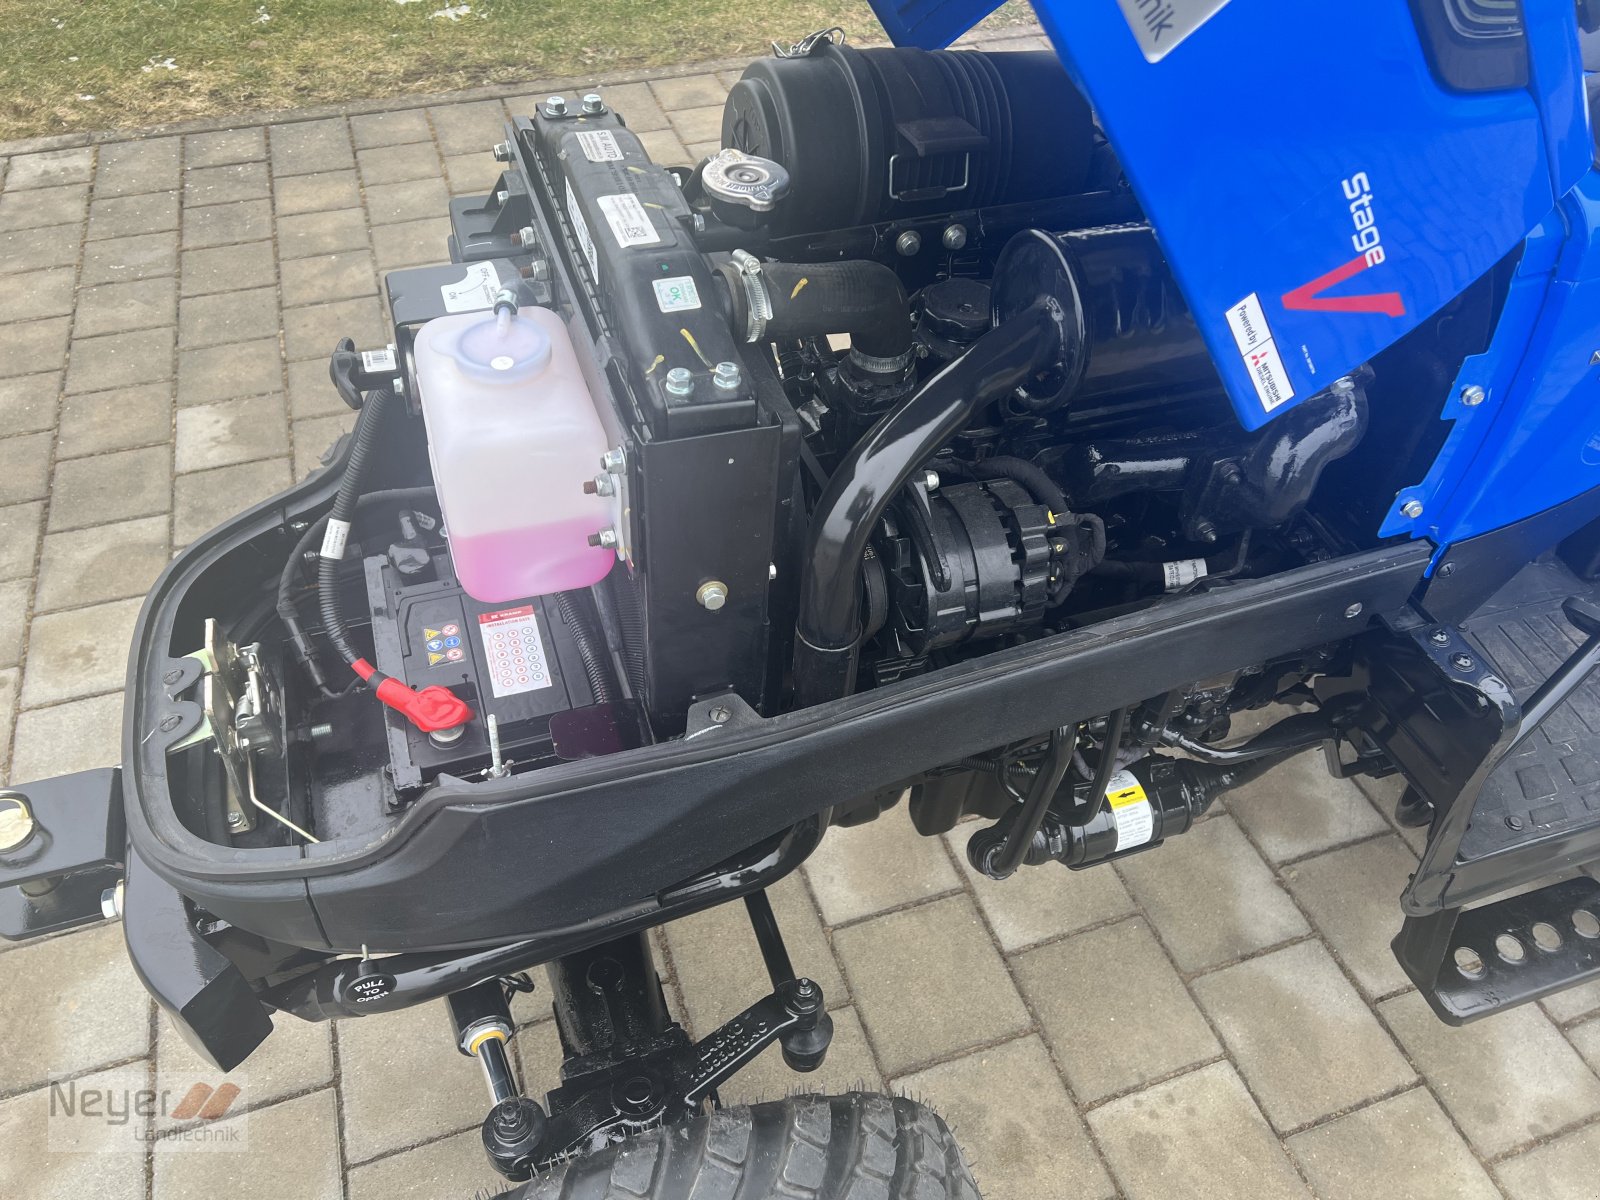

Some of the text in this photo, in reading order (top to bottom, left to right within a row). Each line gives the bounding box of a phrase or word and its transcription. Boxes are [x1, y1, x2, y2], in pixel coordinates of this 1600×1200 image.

[1134, 0, 1174, 42] nik
[1341, 171, 1386, 268] Stage
[669, 286, 682, 301] OK
[1237, 304, 1258, 346] Powered by
[1256, 367, 1276, 405] DIESEL ENGINE
[1260, 362, 1282, 402] MITSUBISHI
[354, 979, 385, 993] PULL
[356, 991, 390, 1003] OPEN
[363, 988, 380, 996] TO
